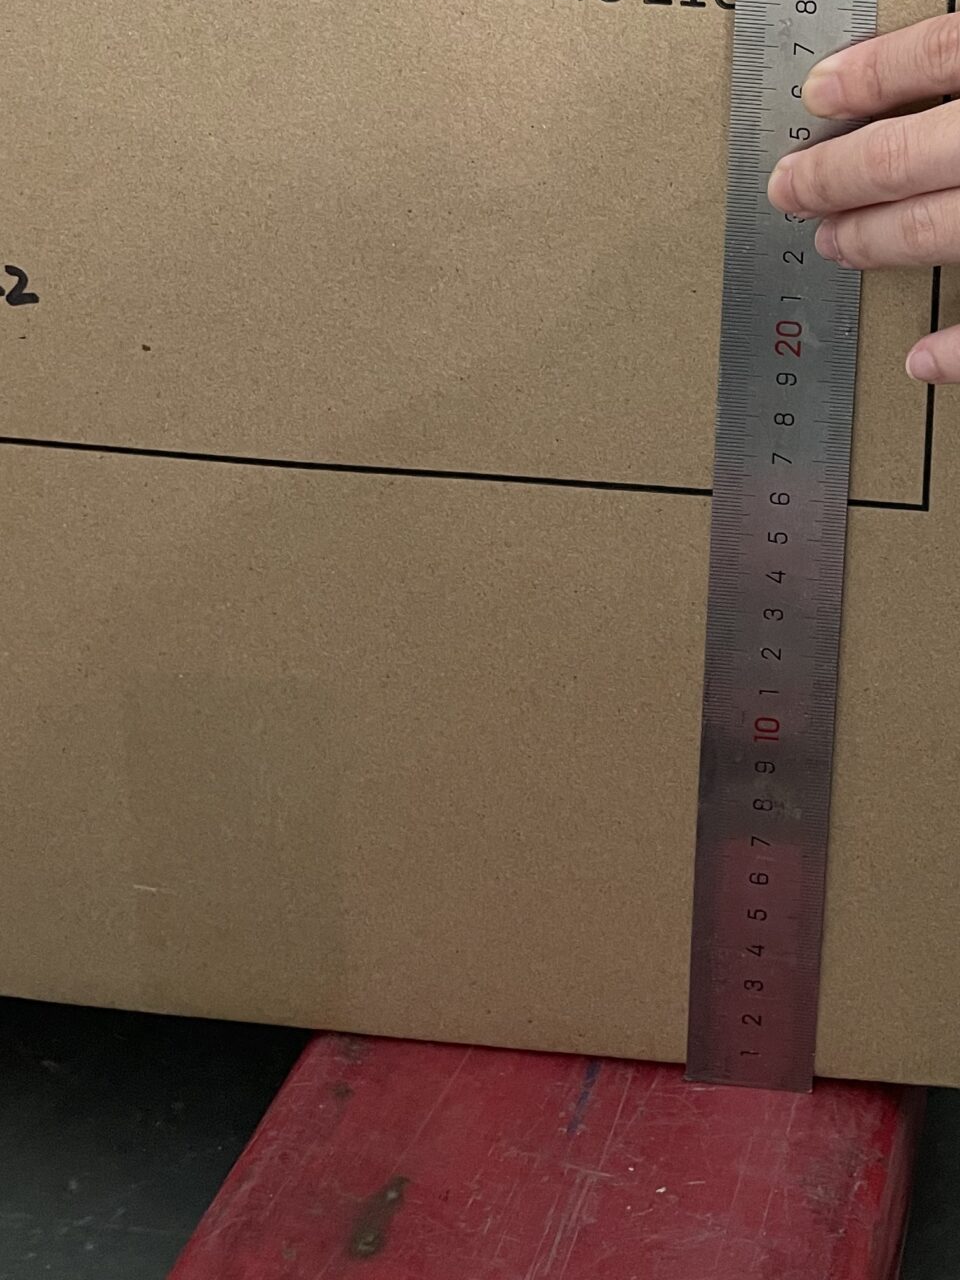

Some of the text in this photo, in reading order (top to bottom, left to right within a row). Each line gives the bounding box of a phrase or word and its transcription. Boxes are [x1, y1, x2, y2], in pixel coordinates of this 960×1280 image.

[796, 0, 816, 14] 8
[794, 43, 814, 55] 7
[790, 127, 810, 140] 5
[783, 251, 803, 264] 2
[775, 320, 802, 357] 20
[776, 373, 797, 386] 9
[774, 413, 794, 426] 8
[772, 453, 792, 464] 7
[770, 492, 790, 505] 6
[768, 532, 788, 544] 5
[766, 570, 786, 584] 4
[764, 608, 783, 621] 3
[761, 648, 781, 660] 2
[754, 717, 779, 742] 10
[755, 761, 775, 774] 9
[753, 799, 773, 811] 8
[752, 836, 771, 846] 7
[750, 873, 768, 885] 6
[748, 909, 767, 921] 5
[746, 944, 764, 956] 4
[744, 980, 763, 991] 3
[742, 1014, 761, 1026] 2
